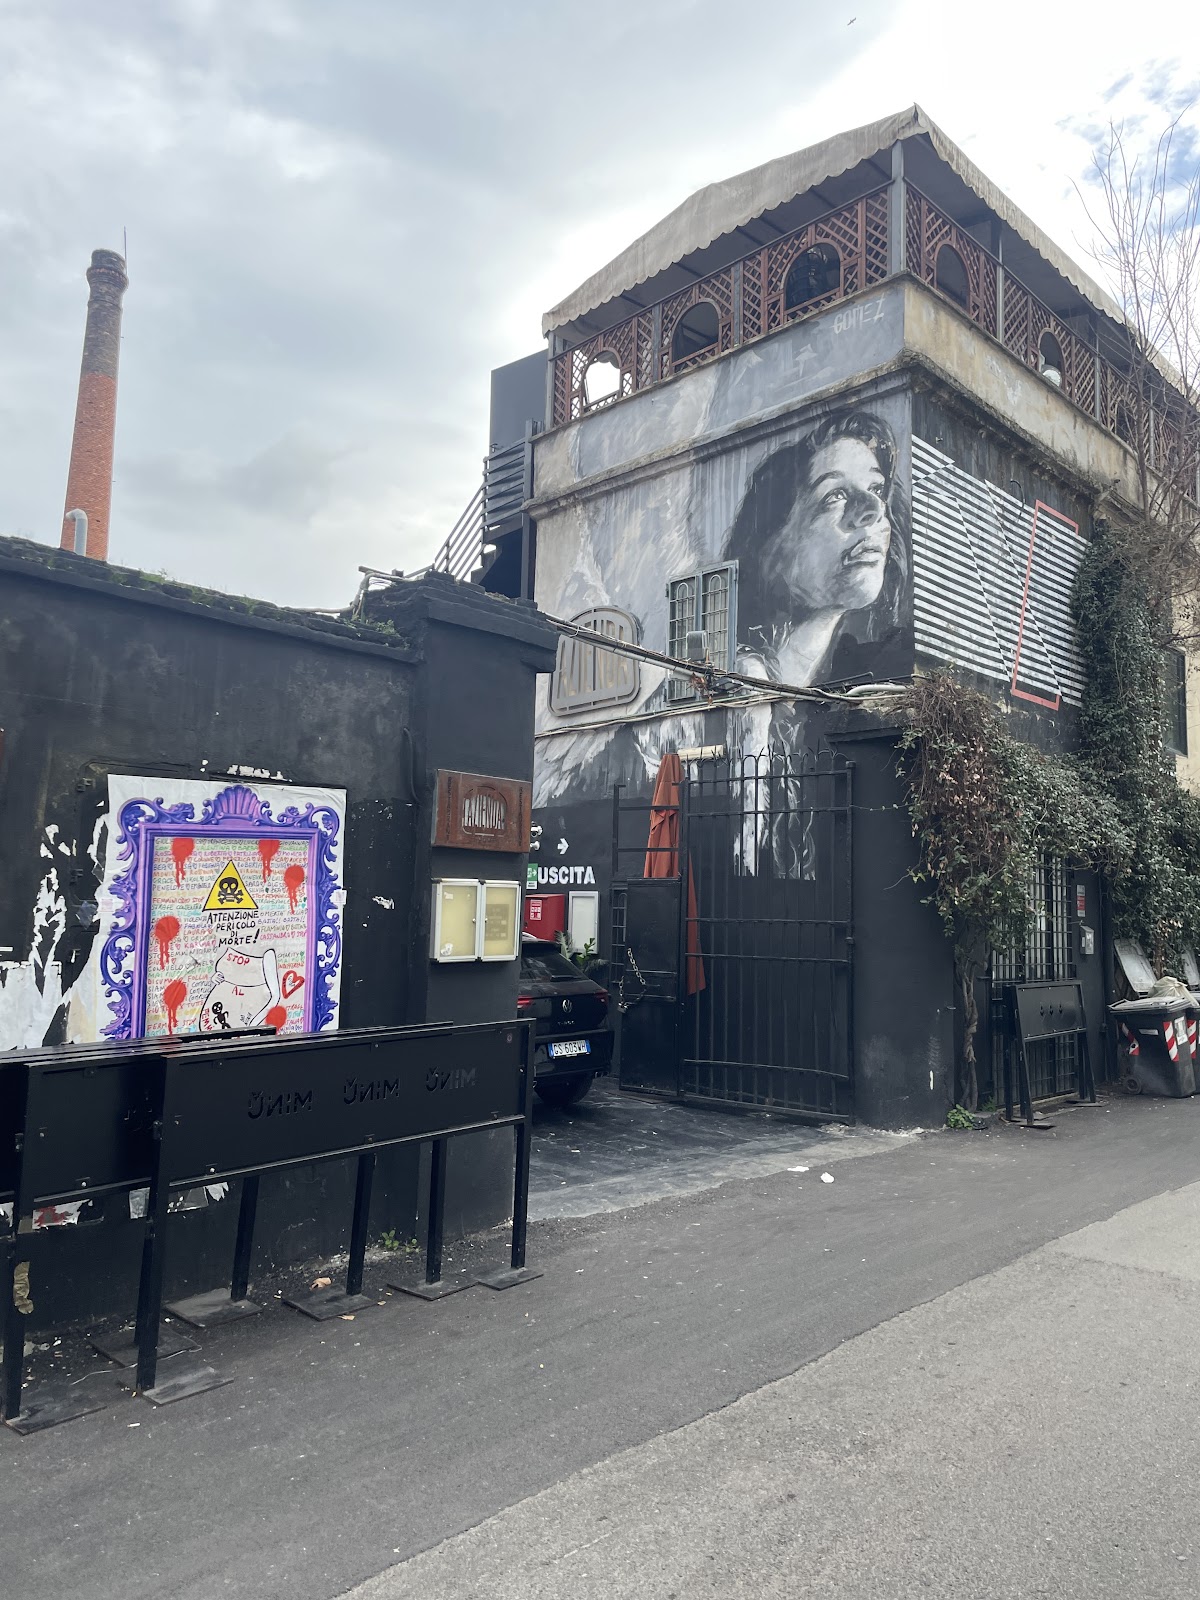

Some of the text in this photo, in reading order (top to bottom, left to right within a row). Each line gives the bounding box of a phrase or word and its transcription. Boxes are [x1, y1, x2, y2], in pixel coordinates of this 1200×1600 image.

[537, 865, 596, 885] USCITA
[207, 910, 259, 924] ATTENZIONE
[215, 921, 256, 933] PERICOLO
[230, 930, 238, 938] DI
[226, 953, 250, 966] STOP
[231, 985, 245, 996] AL
